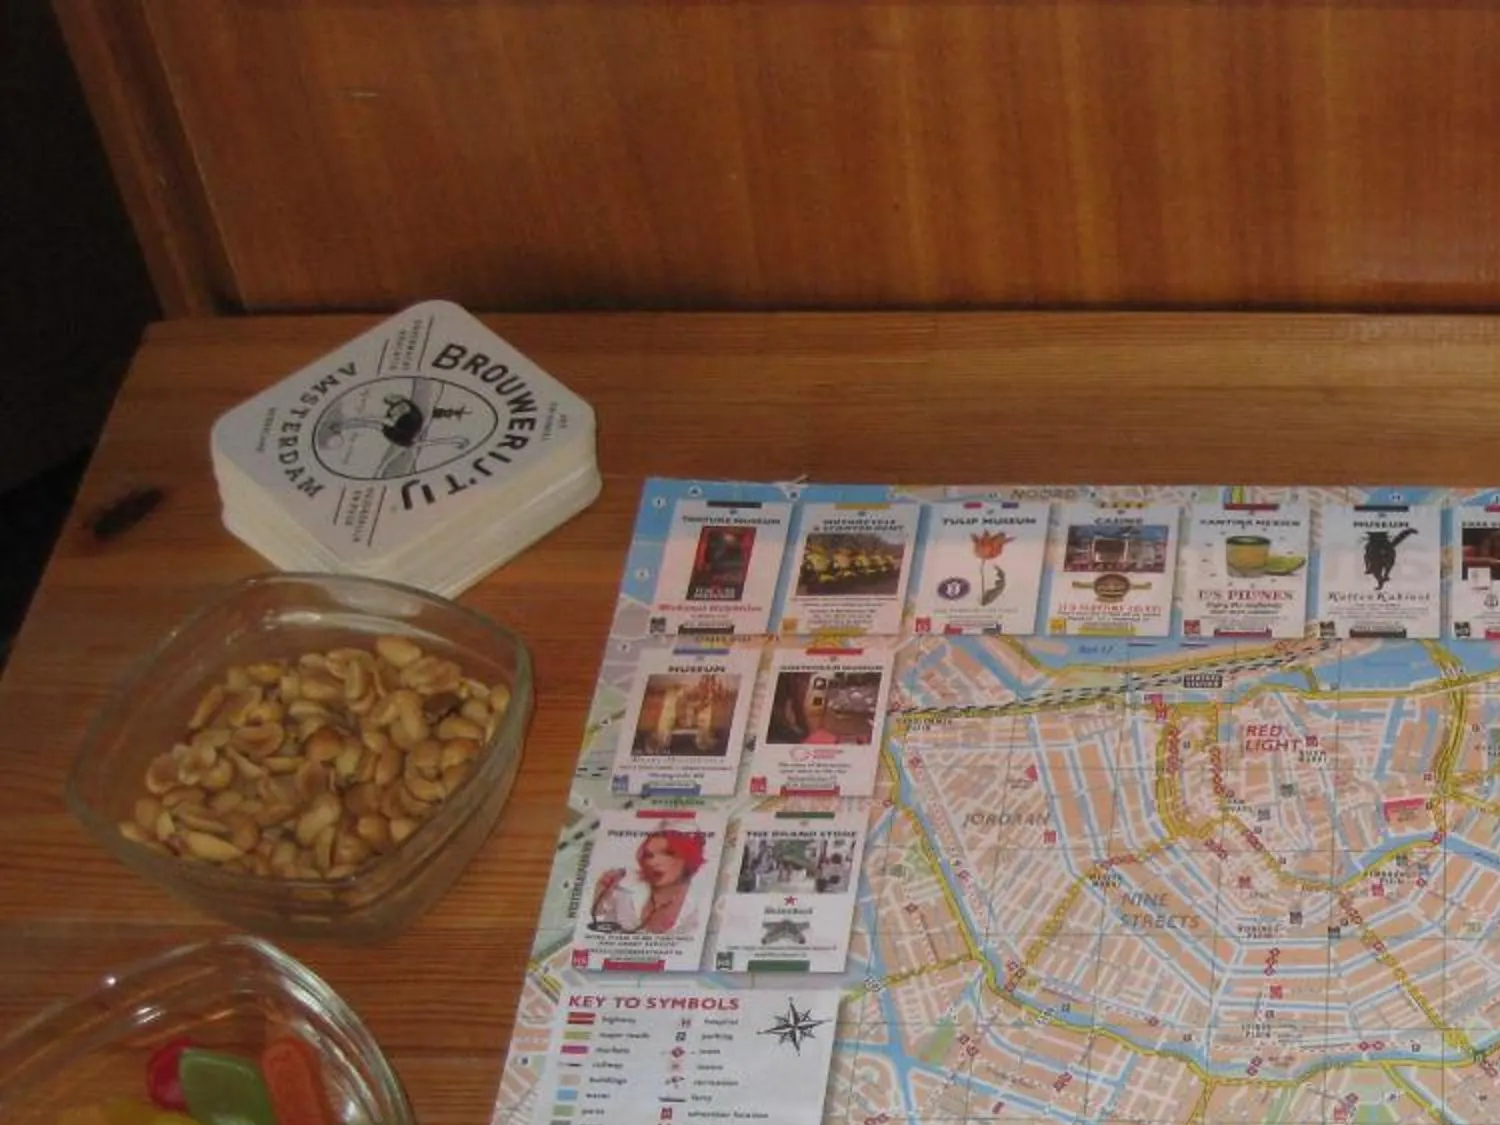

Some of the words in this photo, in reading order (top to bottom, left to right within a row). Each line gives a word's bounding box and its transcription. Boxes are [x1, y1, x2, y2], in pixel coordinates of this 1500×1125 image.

[431, 343, 538, 477] BROUWERIJ
[276, 361, 359, 499] AMSTERDAM
[942, 517, 978, 525] TULIP
[982, 517, 1037, 526] MUSEUM
[1352, 520, 1410, 528] MUSEUM
[1246, 724, 1285, 738] RED
[1245, 739, 1300, 753] LIGHT
[961, 811, 1052, 829] JORDAAN
[1122, 892, 1169, 907] NINE
[1120, 913, 1200, 930] STREETS
[567, 994, 605, 1009] KEY
[614, 995, 640, 1010] TO
[646, 996, 740, 1011] SYMBOLS
